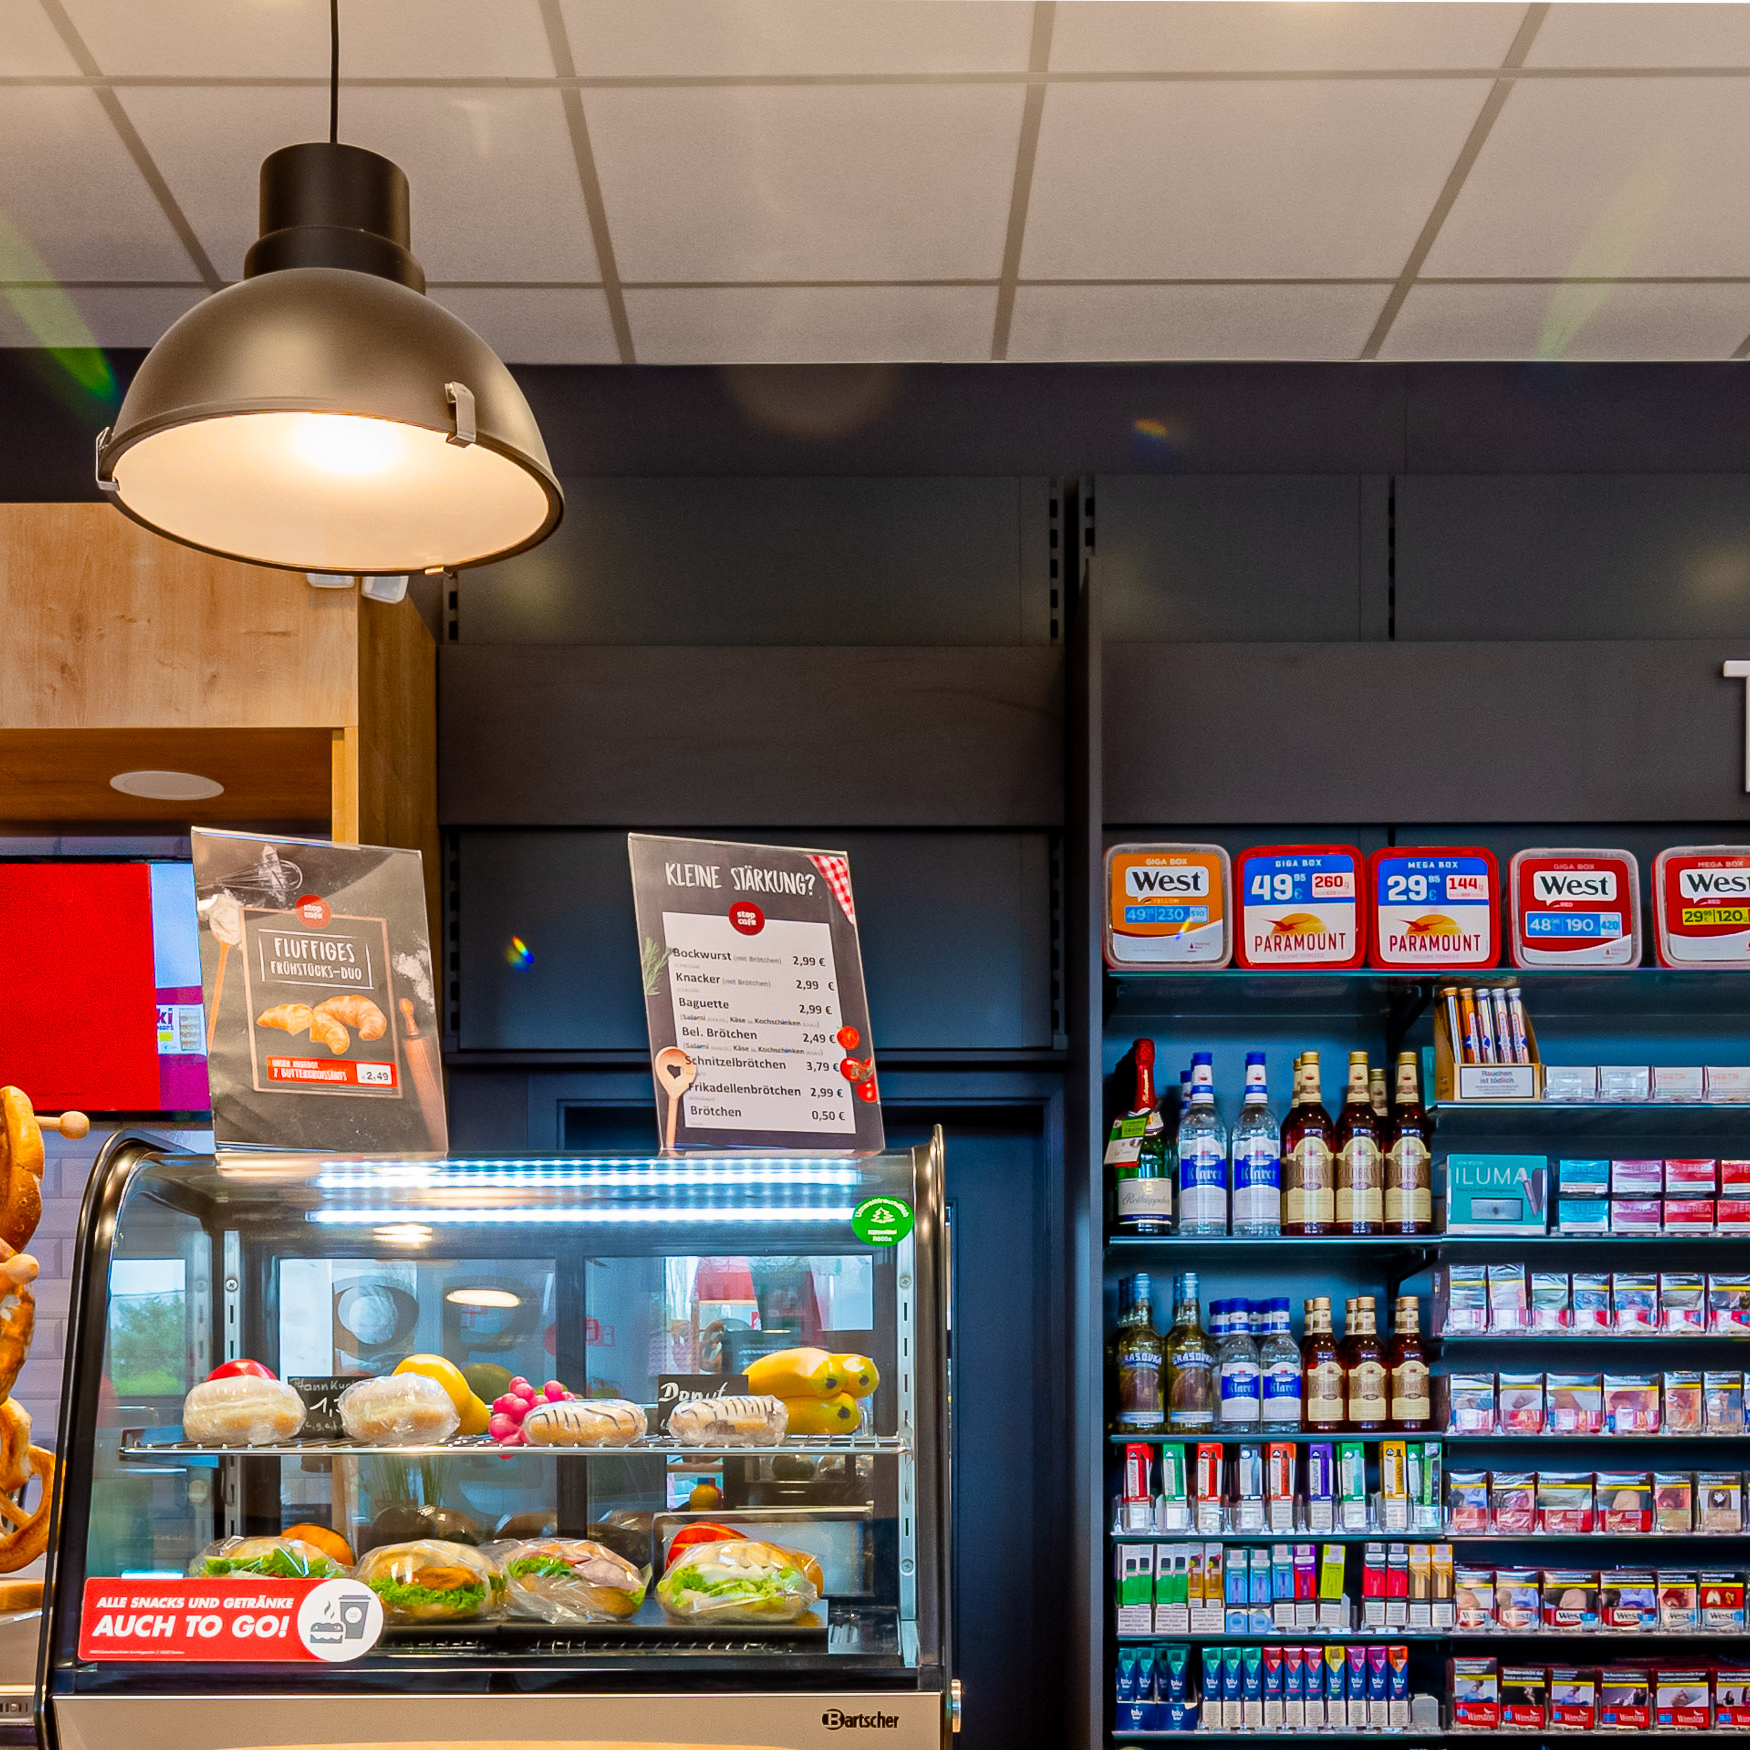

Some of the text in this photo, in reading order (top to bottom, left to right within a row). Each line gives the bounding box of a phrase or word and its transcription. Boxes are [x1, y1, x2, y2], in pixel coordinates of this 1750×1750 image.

[1302, 859, 1322, 867] BOX
[1438, 861, 1458, 869] BOX
[665, 862, 816, 896] KLEINE STÄRKUNG?
[1131, 871, 1201, 892] West
[1538, 874, 1610, 896] West
[274, 937, 355, 963] FLUFFIGES
[1254, 932, 1347, 952] PARAMOUNT
[1389, 934, 1481, 952] PARAMOUNT
[673, 947, 731, 961] Bockwurst
[793, 956, 816, 967] 2,99
[270, 960, 362, 980] FRÜHSTÜCKS-DUO
[675, 972, 720, 985] Knacker
[796, 980, 819, 991] 2,99
[679, 998, 729, 1010] Baguette
[799, 1004, 822, 1016] 2,99
[682, 1027, 703, 1037] Bel.
[707, 1027, 758, 1040] Brötchen
[803, 1033, 826, 1045] 2,49
[685, 1055, 786, 1070] Schnitzelbrötchen
[806, 1062, 830, 1073] 3,79
[688, 1082, 801, 1097] Frikadellenbrötchen
[810, 1087, 833, 1099] 2,99
[690, 1106, 742, 1117] Brötchen
[811, 1111, 835, 1122] 0,50
[96, 1595, 294, 1609] ALLE SNACKS UND GETRÄNKE
[92, 1615, 290, 1637] AUCH TO GO!
[821, 1708, 900, 1730] Bartscher
